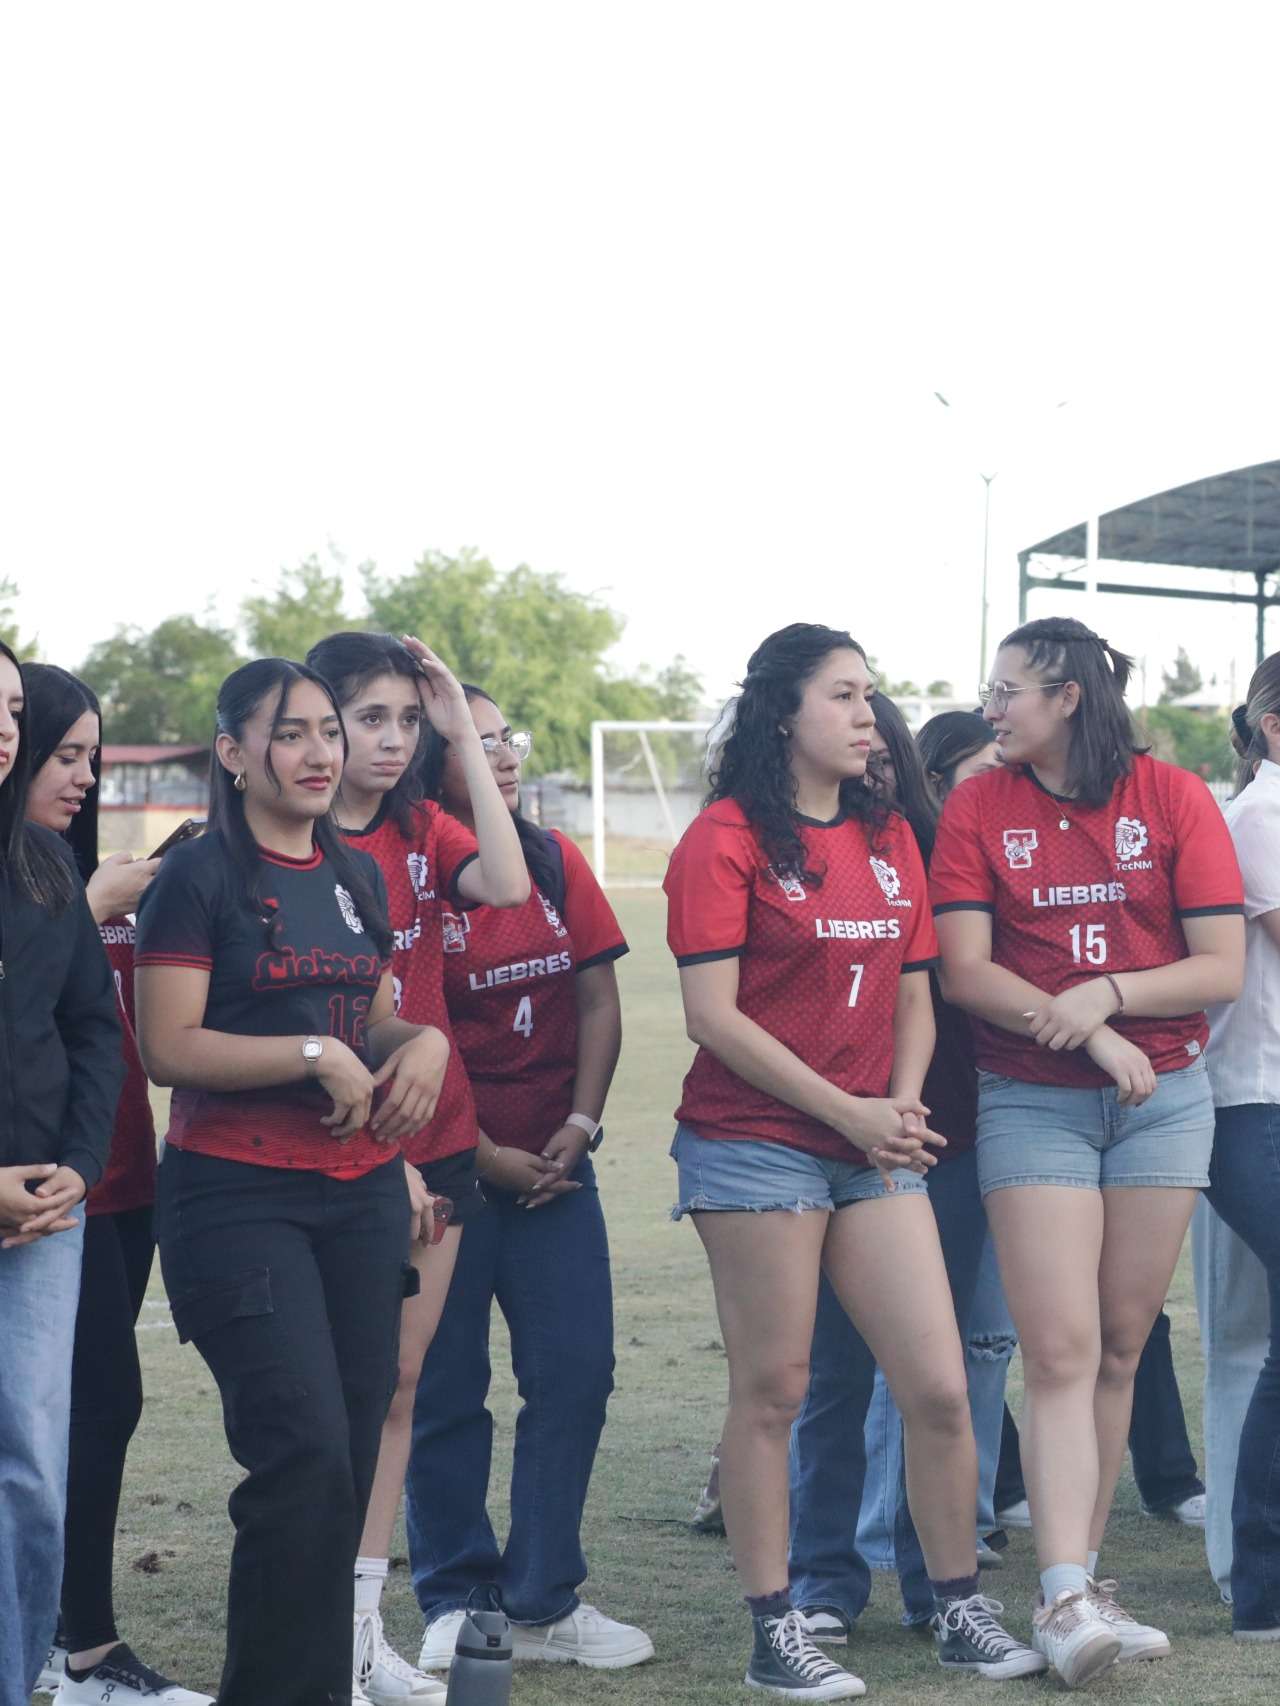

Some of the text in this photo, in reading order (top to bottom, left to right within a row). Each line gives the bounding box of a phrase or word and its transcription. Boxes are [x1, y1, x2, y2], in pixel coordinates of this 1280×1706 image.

[1115, 860, 1153, 872] TecNM
[1032, 881, 1127, 907] LIEBRES
[815, 918, 900, 939] LIEBRES
[1069, 924, 1107, 965] 15
[469, 951, 571, 991] LIEBRES
[848, 964, 865, 1008] 7
[513, 995, 534, 1038] 4
